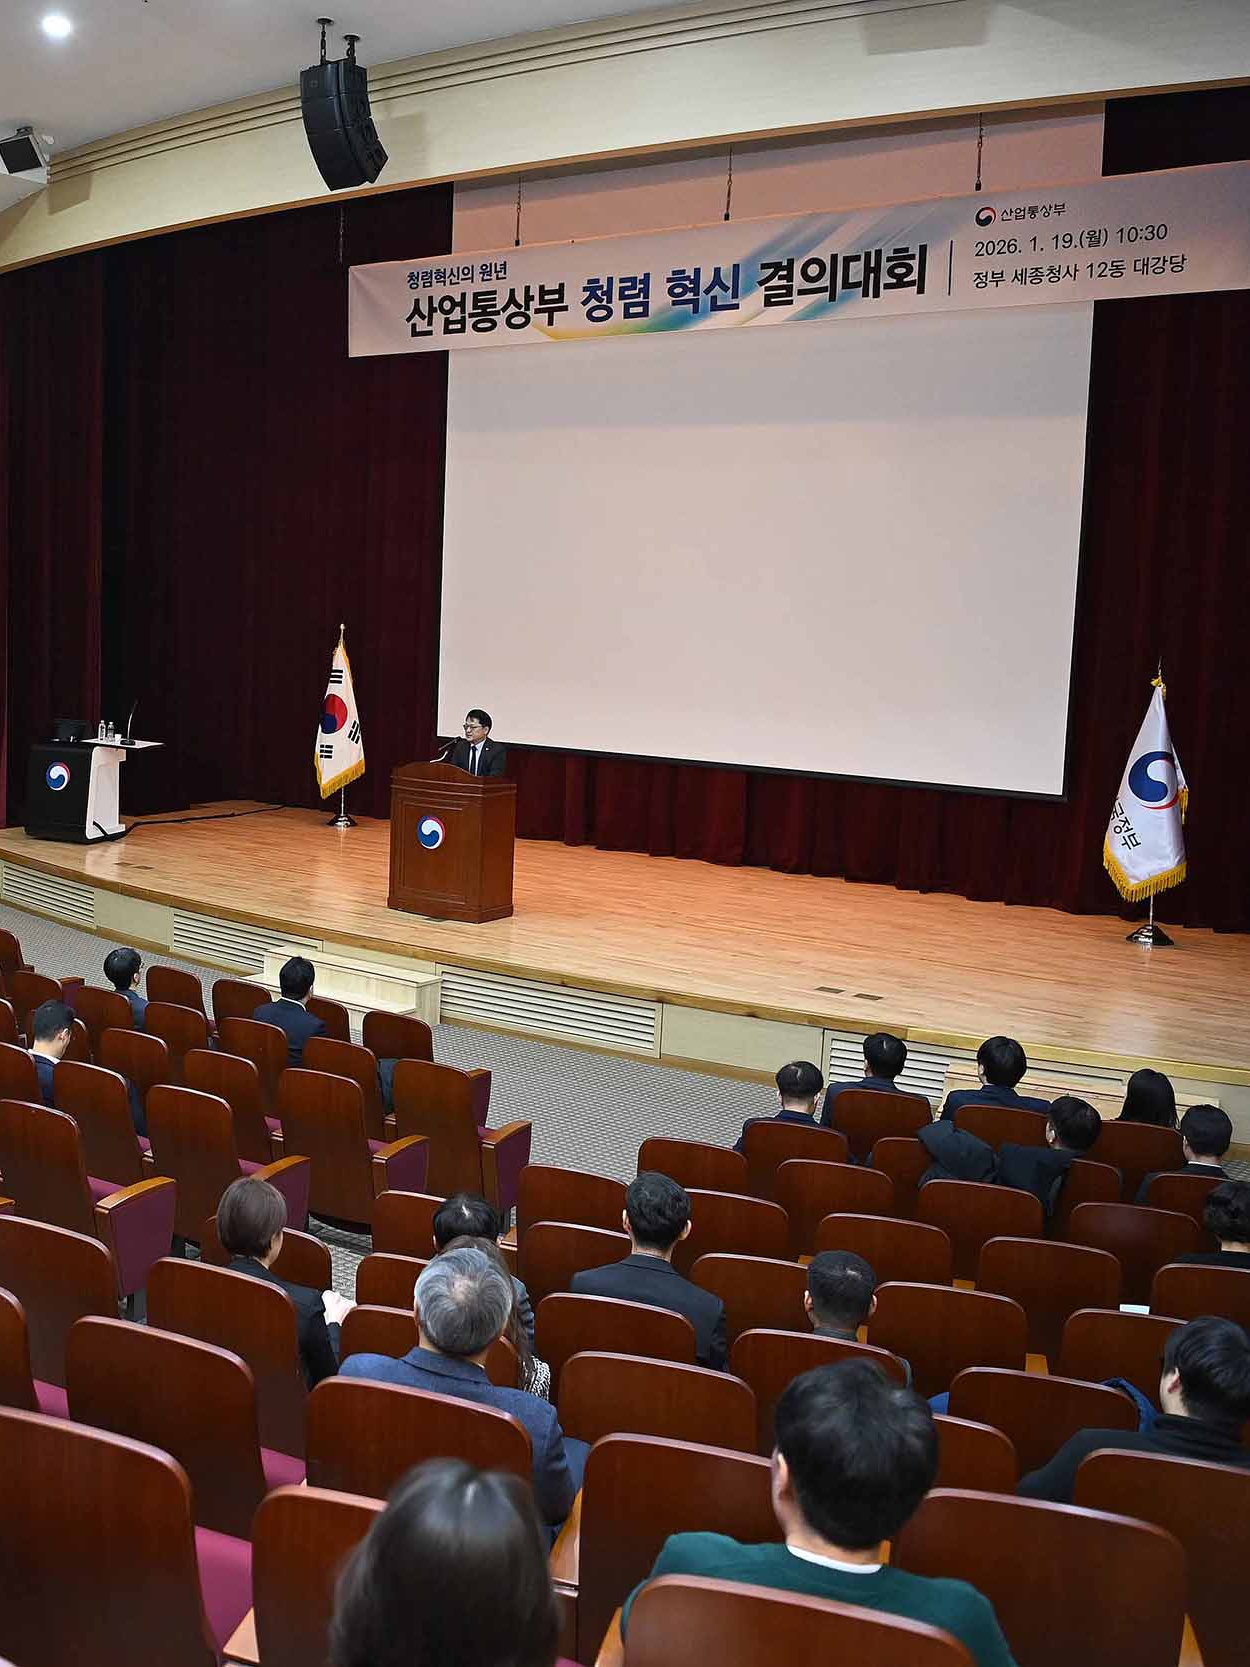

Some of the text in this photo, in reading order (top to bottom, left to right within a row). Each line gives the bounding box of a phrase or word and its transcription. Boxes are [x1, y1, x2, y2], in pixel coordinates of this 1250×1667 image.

[1000, 203, 1067, 222] 산업통상부
[974, 224, 1168, 257] 2026. 1. 19.(월) 10:30
[407, 261, 508, 290] 청렴혁신의 원년
[973, 254, 1188, 289] 정부 세종청사 12동 대강당
[405, 244, 928, 337] 산업통상부 청렴 혁신 결의대회
